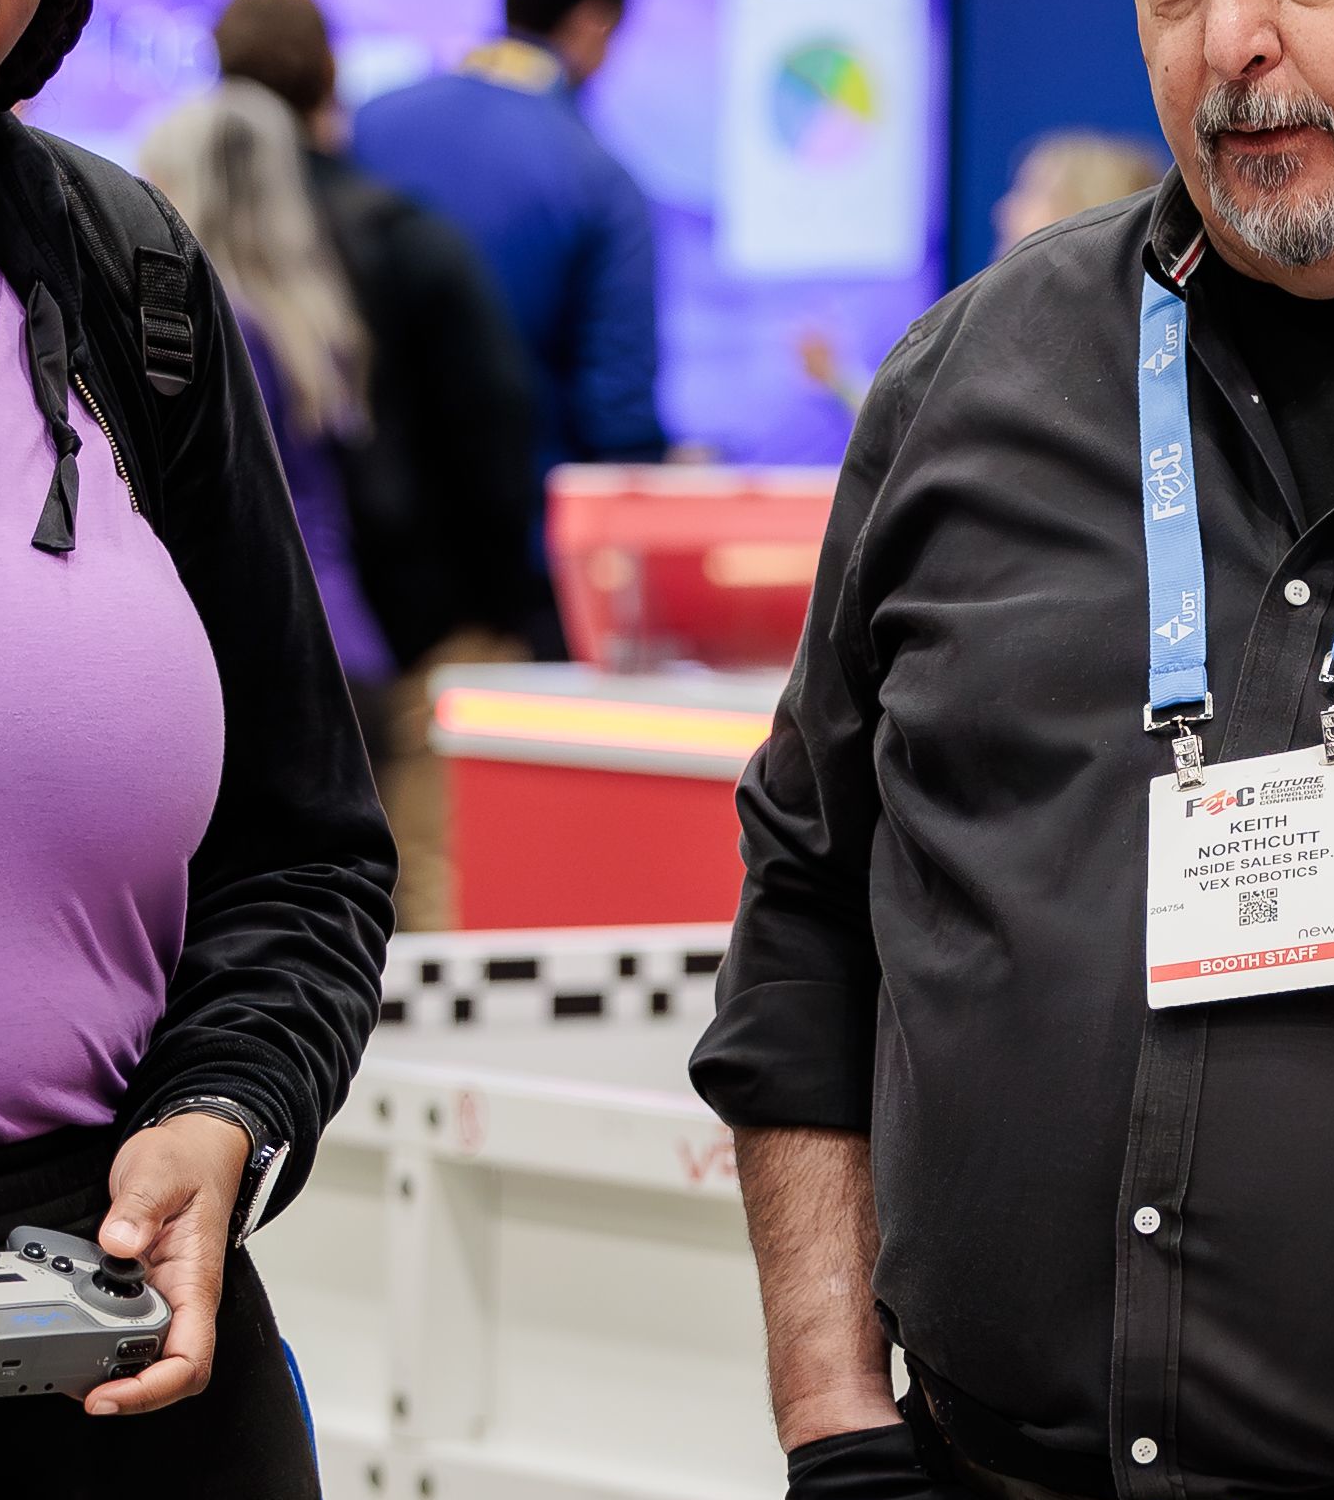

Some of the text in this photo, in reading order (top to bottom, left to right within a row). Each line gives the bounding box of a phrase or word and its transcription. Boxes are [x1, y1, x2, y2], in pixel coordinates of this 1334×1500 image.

[1165, 323, 1178, 352] UDT
[1181, 591, 1197, 622] UDT
[1260, 775, 1324, 791] FUTURE
[1270, 783, 1324, 794] EDUCATION
[1259, 793, 1324, 806] CONFERENCE
[1229, 814, 1288, 835] KEITH
[1197, 830, 1321, 860] NORTHCUTT
[1183, 848, 1334, 879] INSIDE SALES REP.
[1198, 864, 1319, 892] VEX ROBOTICS
[1198, 945, 1319, 975] BOOTH STAFF
